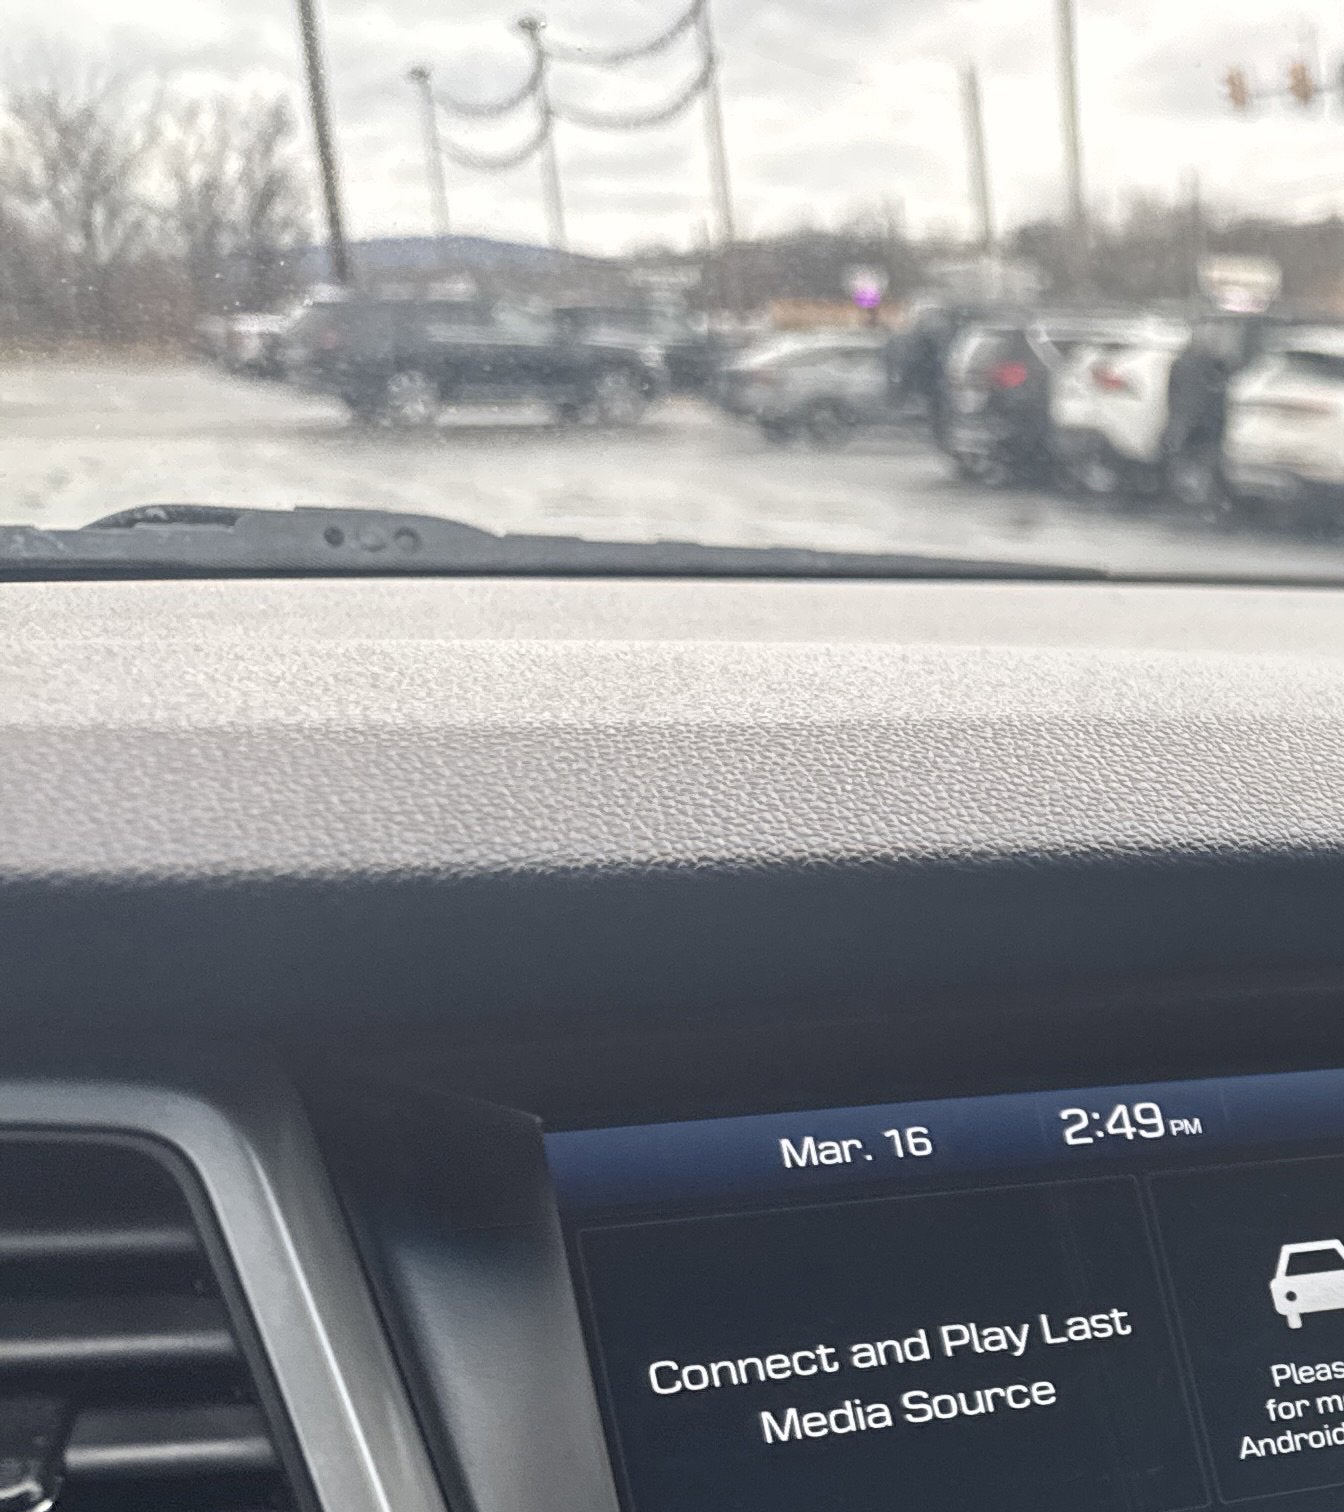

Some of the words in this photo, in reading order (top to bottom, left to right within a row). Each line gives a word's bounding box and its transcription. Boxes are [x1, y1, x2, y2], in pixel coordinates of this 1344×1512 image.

[779, 1135, 872, 1168] Mar.
[883, 1126, 932, 1158] 16
[648, 1343, 839, 1395] Connect
[850, 1329, 931, 1369] and
[943, 1322, 1029, 1358] Play
[1040, 1308, 1132, 1344] Last
[760, 1399, 893, 1444] Media
[902, 1379, 1057, 1423] Source
[1266, 1398, 1309, 1422] for
